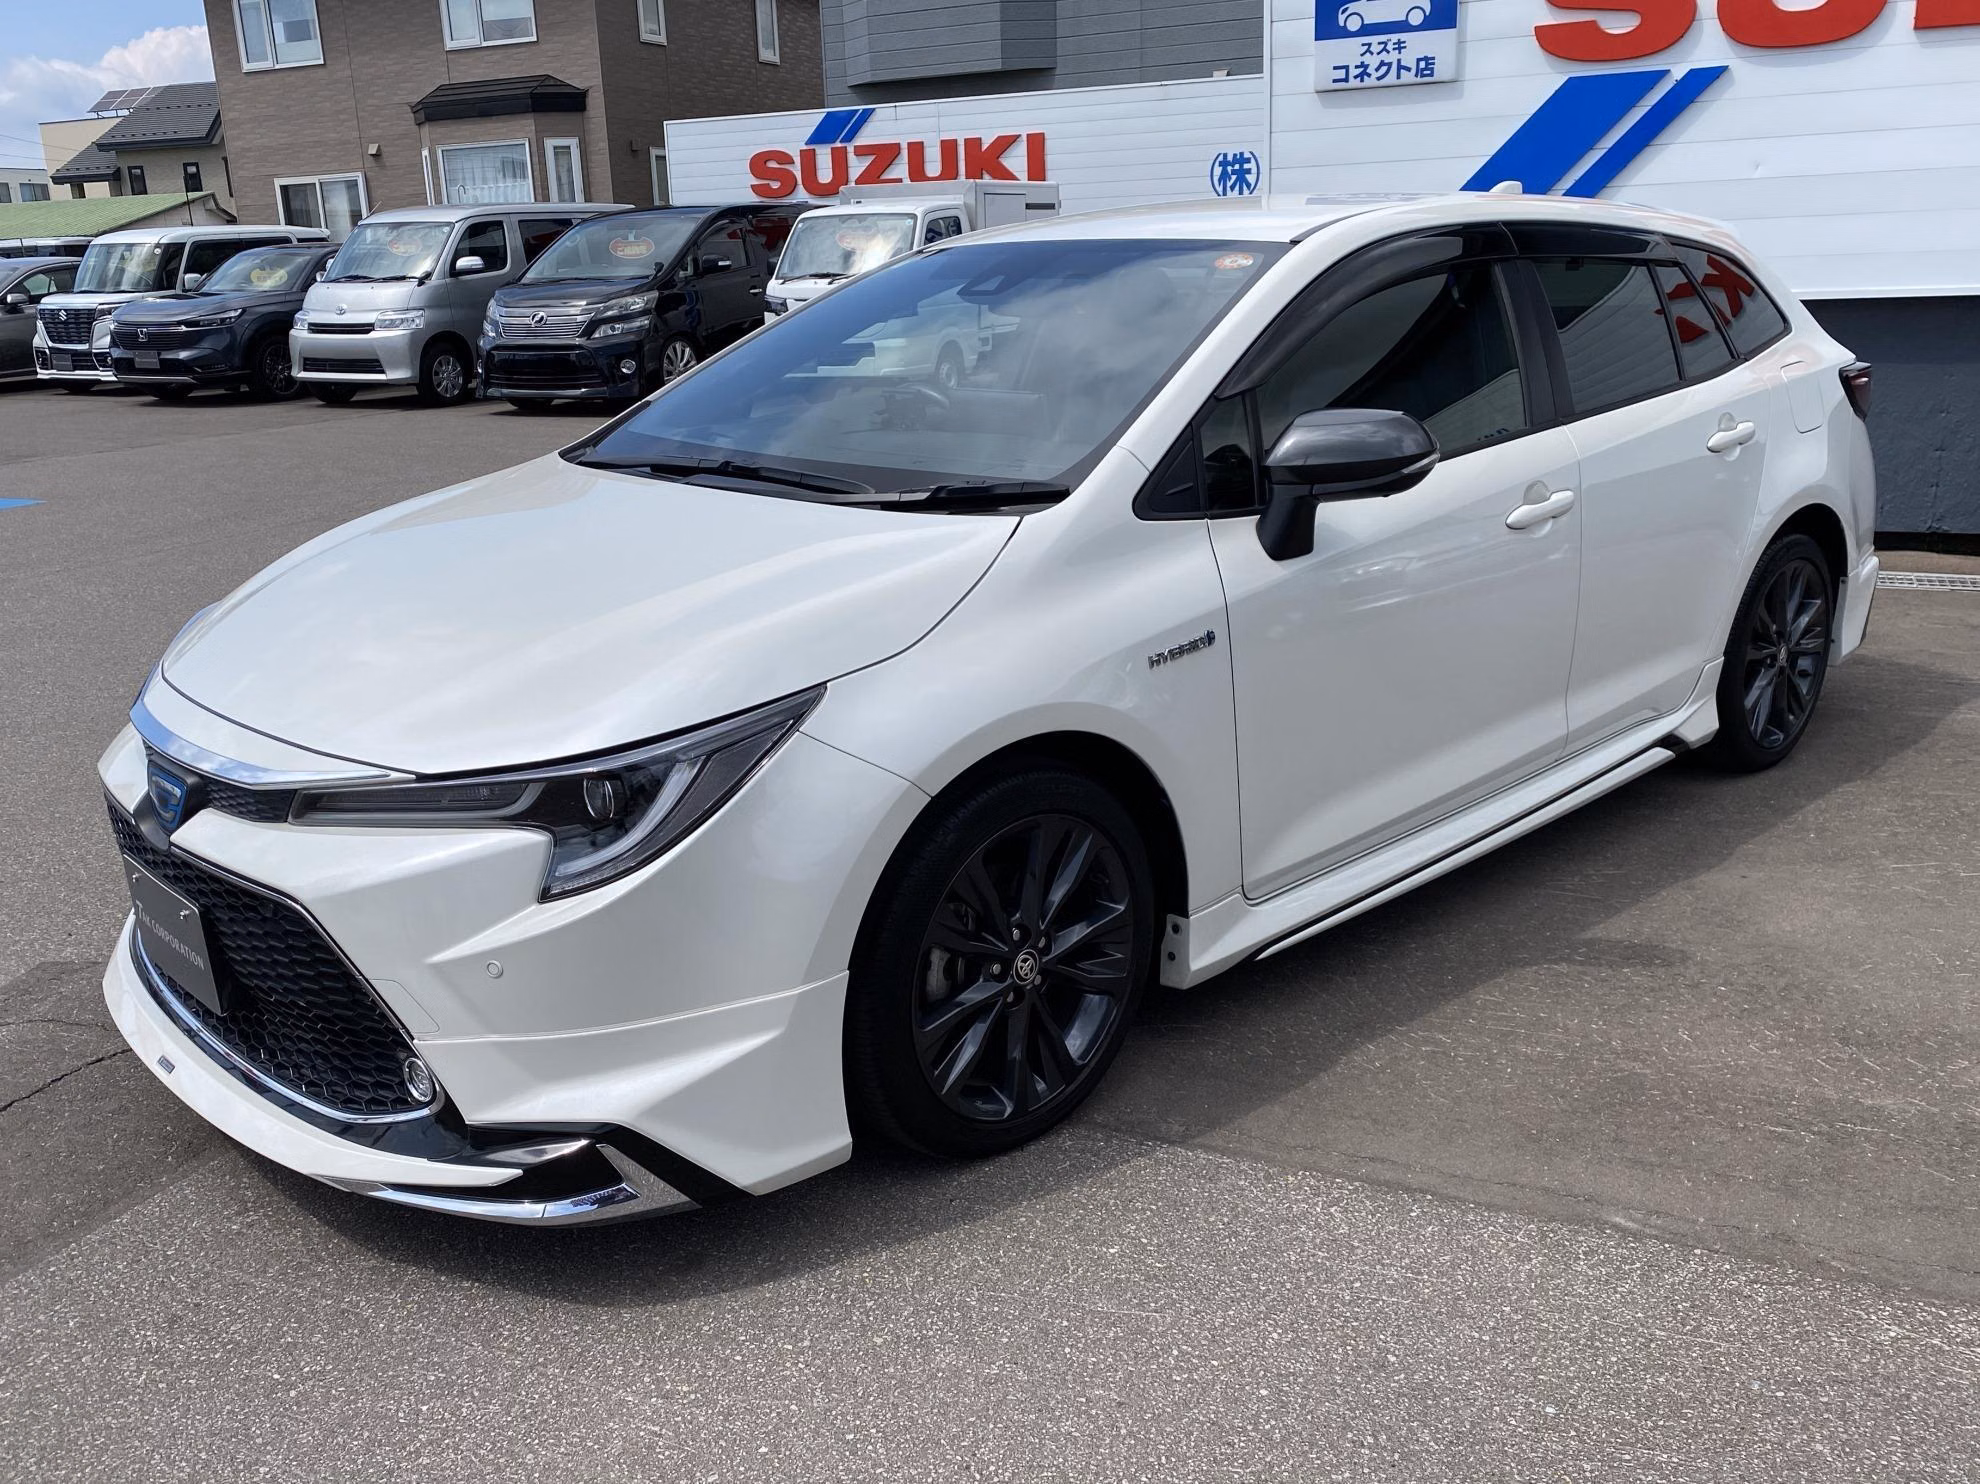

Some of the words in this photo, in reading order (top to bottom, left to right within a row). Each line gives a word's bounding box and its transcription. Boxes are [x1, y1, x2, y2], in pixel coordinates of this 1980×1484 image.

[1360, 38, 1407, 57] スズキ
[1332, 55, 1436, 84] コネクト店
[749, 132, 1046, 198] SUZUKI
[151, 920, 204, 970] CORPORATION
